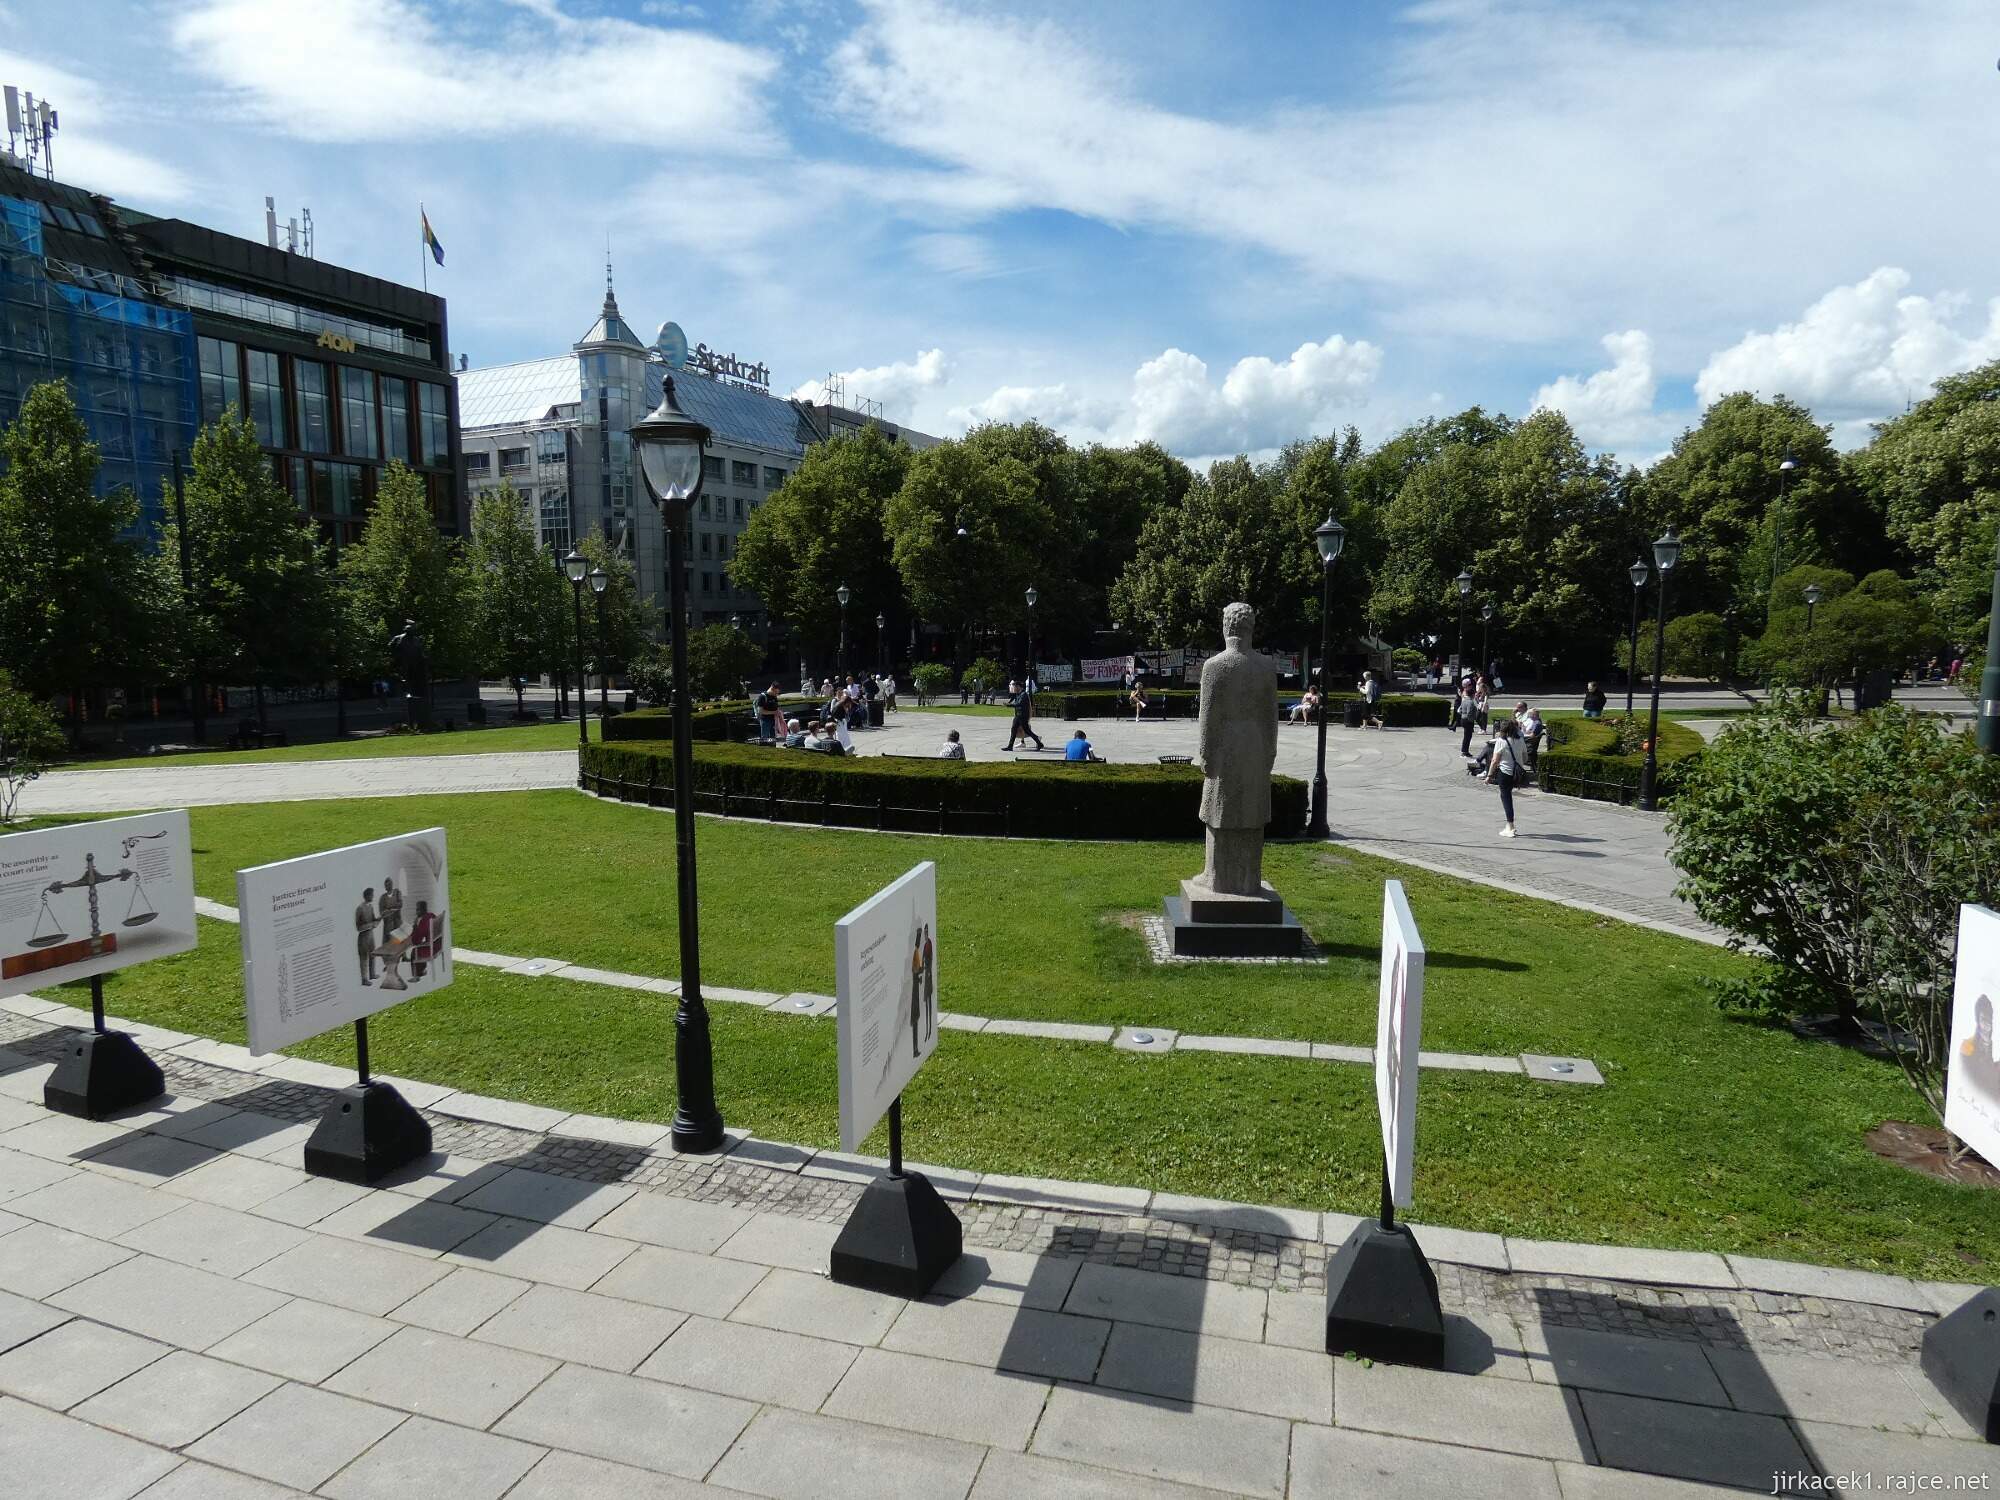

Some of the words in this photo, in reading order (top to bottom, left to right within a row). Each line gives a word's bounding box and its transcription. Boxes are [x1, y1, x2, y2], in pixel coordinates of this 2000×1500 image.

[316, 331, 355, 354] AON
[697, 342, 770, 387] Statkraft
[13, 855, 48, 867] assembly
[3, 868, 24, 878] court
[272, 890, 296, 904] Justice
